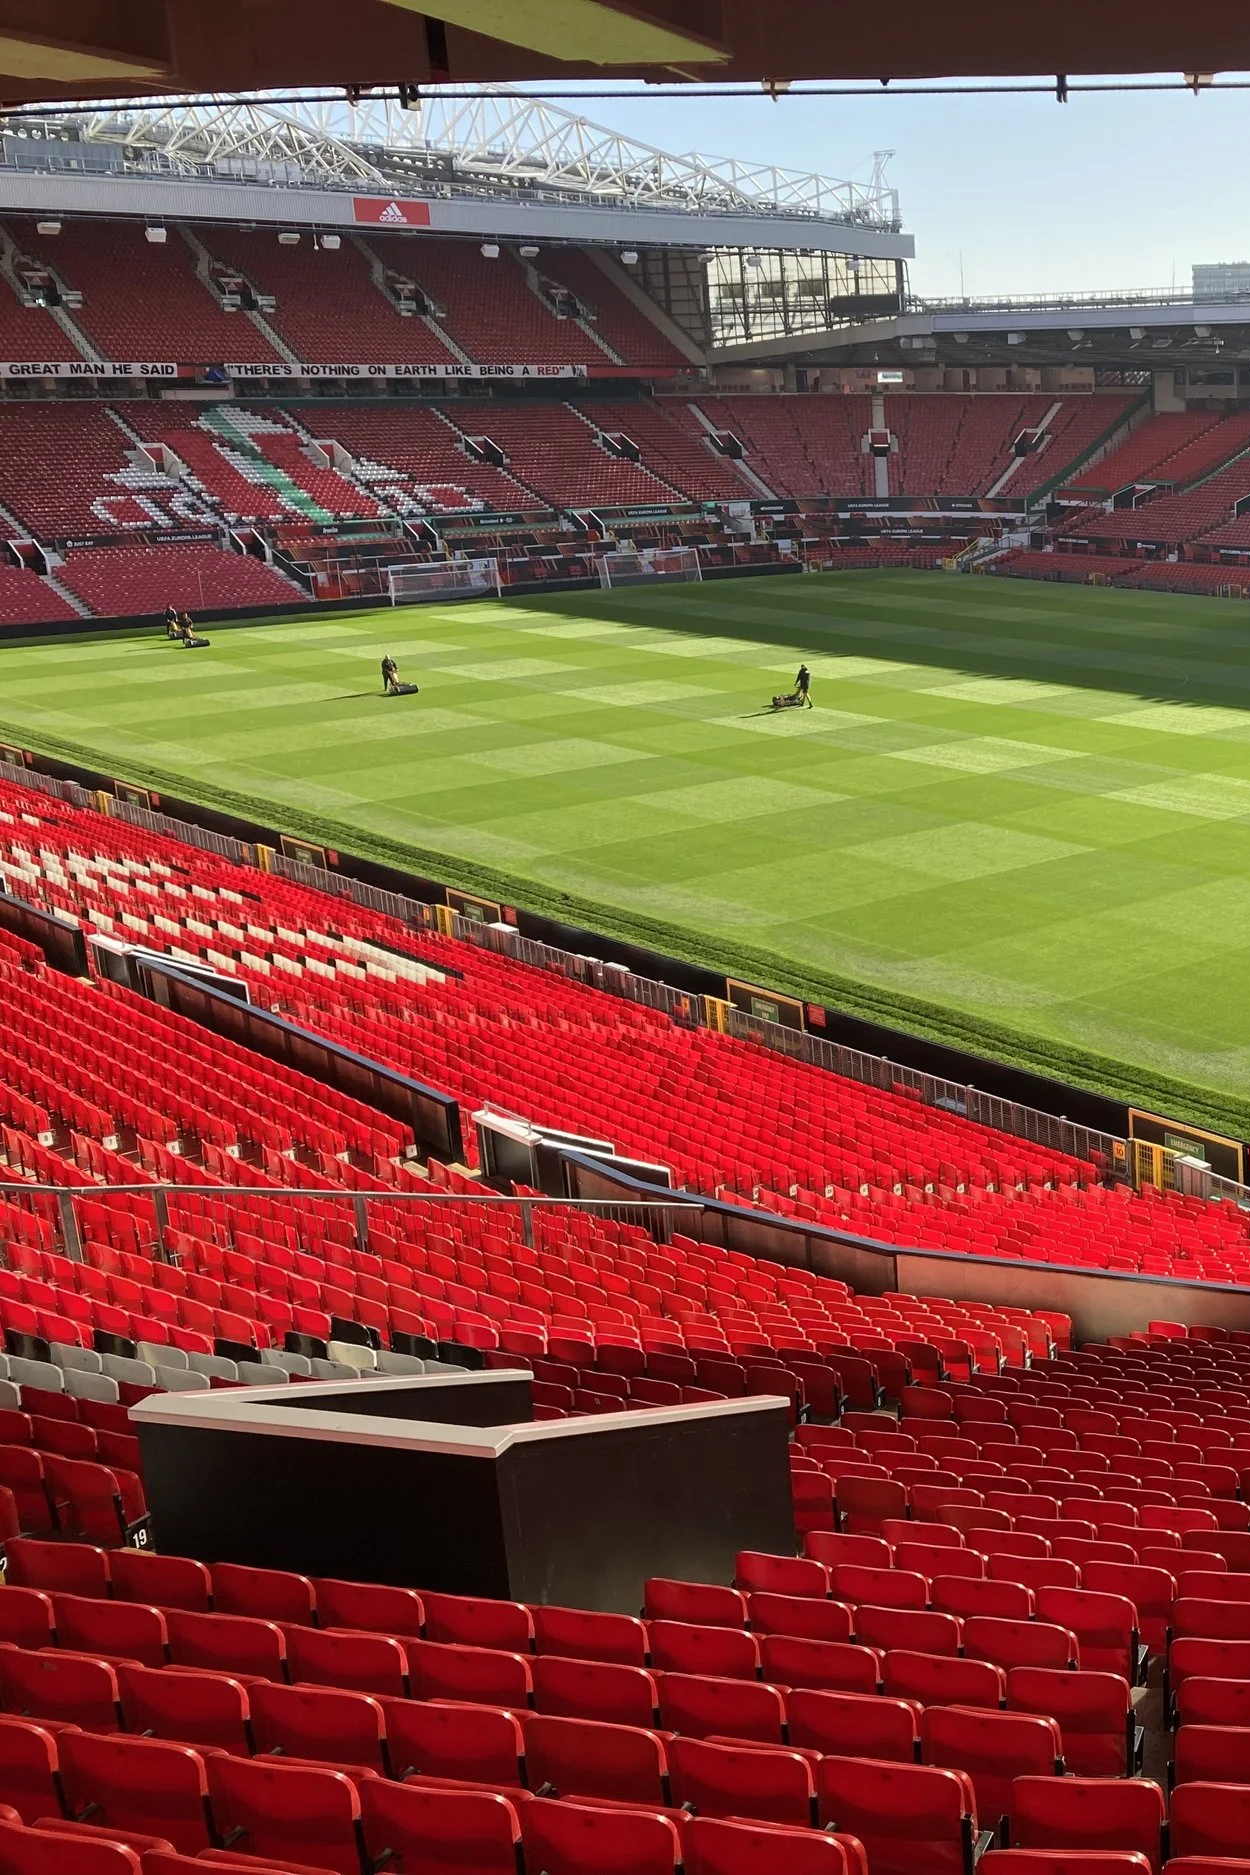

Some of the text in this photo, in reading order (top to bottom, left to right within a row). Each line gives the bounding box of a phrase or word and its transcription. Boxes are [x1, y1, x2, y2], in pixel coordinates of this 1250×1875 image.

[380, 214, 407, 223] adidas
[9, 364, 175, 375] GREAT MAN HE SAID
[301, 365, 359, 376] NOTHING
[368, 365, 386, 376] ON
[395, 366, 437, 376] EARTH
[445, 366, 472, 376] LIKE
[479, 366, 514, 376] BEING
[522, 366, 530, 376] A
[1170, 1138, 1199, 1153] EMERGENCY
[1115, 1147, 1123, 1157] 10
[132, 1528, 147, 1549] 19
